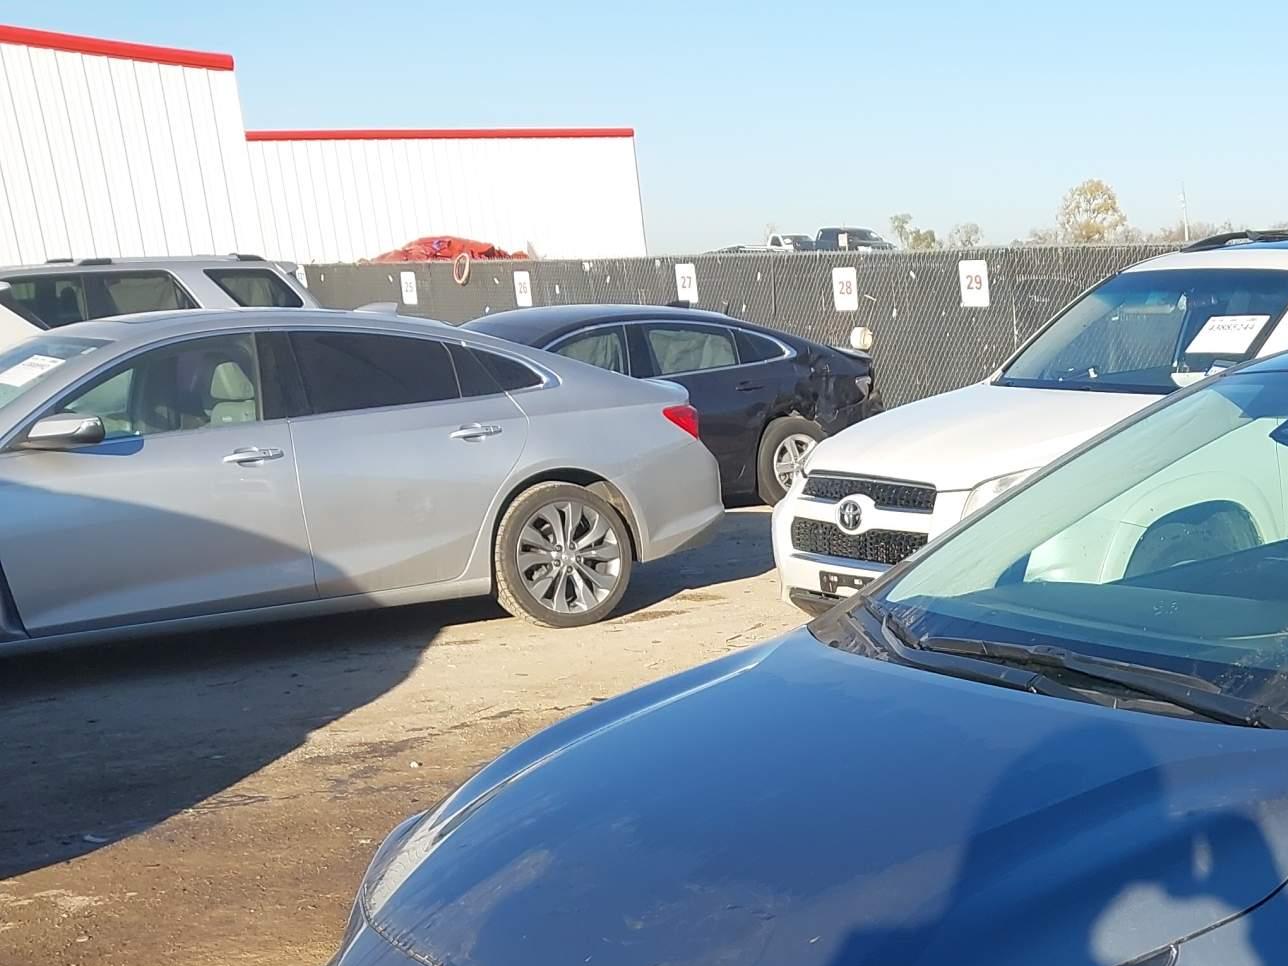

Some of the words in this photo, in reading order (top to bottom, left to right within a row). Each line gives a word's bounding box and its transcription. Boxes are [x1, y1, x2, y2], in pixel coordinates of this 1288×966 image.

[518, 281, 528, 294] 26
[680, 275, 692, 289] 27
[838, 280, 853, 295] 28
[965, 274, 983, 290] 29
